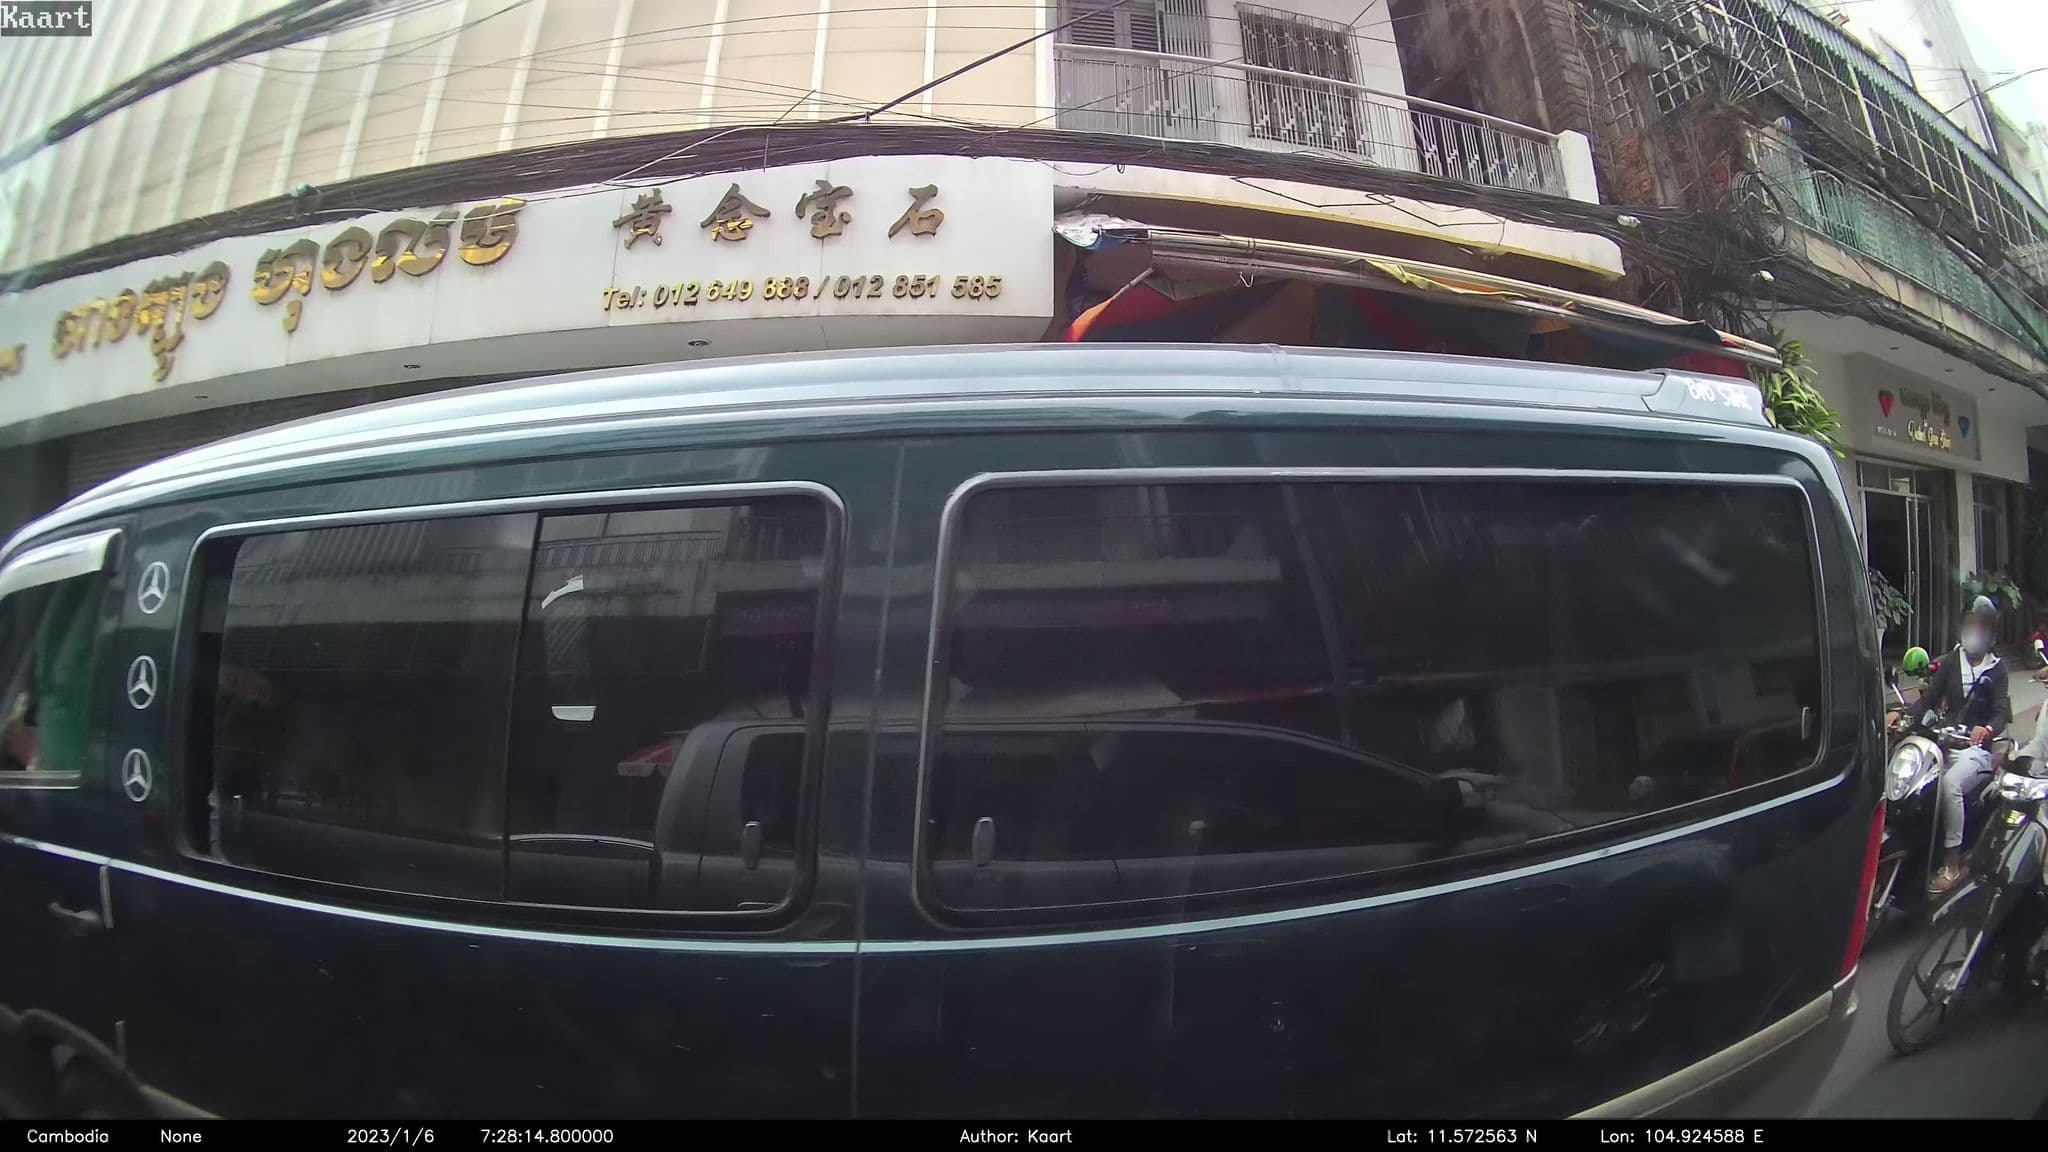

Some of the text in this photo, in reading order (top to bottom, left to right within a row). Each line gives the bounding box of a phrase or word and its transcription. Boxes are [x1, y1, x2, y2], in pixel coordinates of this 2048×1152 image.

[612, 179, 945, 250] 黄念宝石
[602, 286, 647, 311] Tel:
[653, 280, 701, 309] 012
[706, 278, 754, 301] 649
[762, 276, 810, 300] 888
[833, 274, 884, 299] 012
[892, 274, 941, 299] 851
[951, 275, 1002, 300] 585
